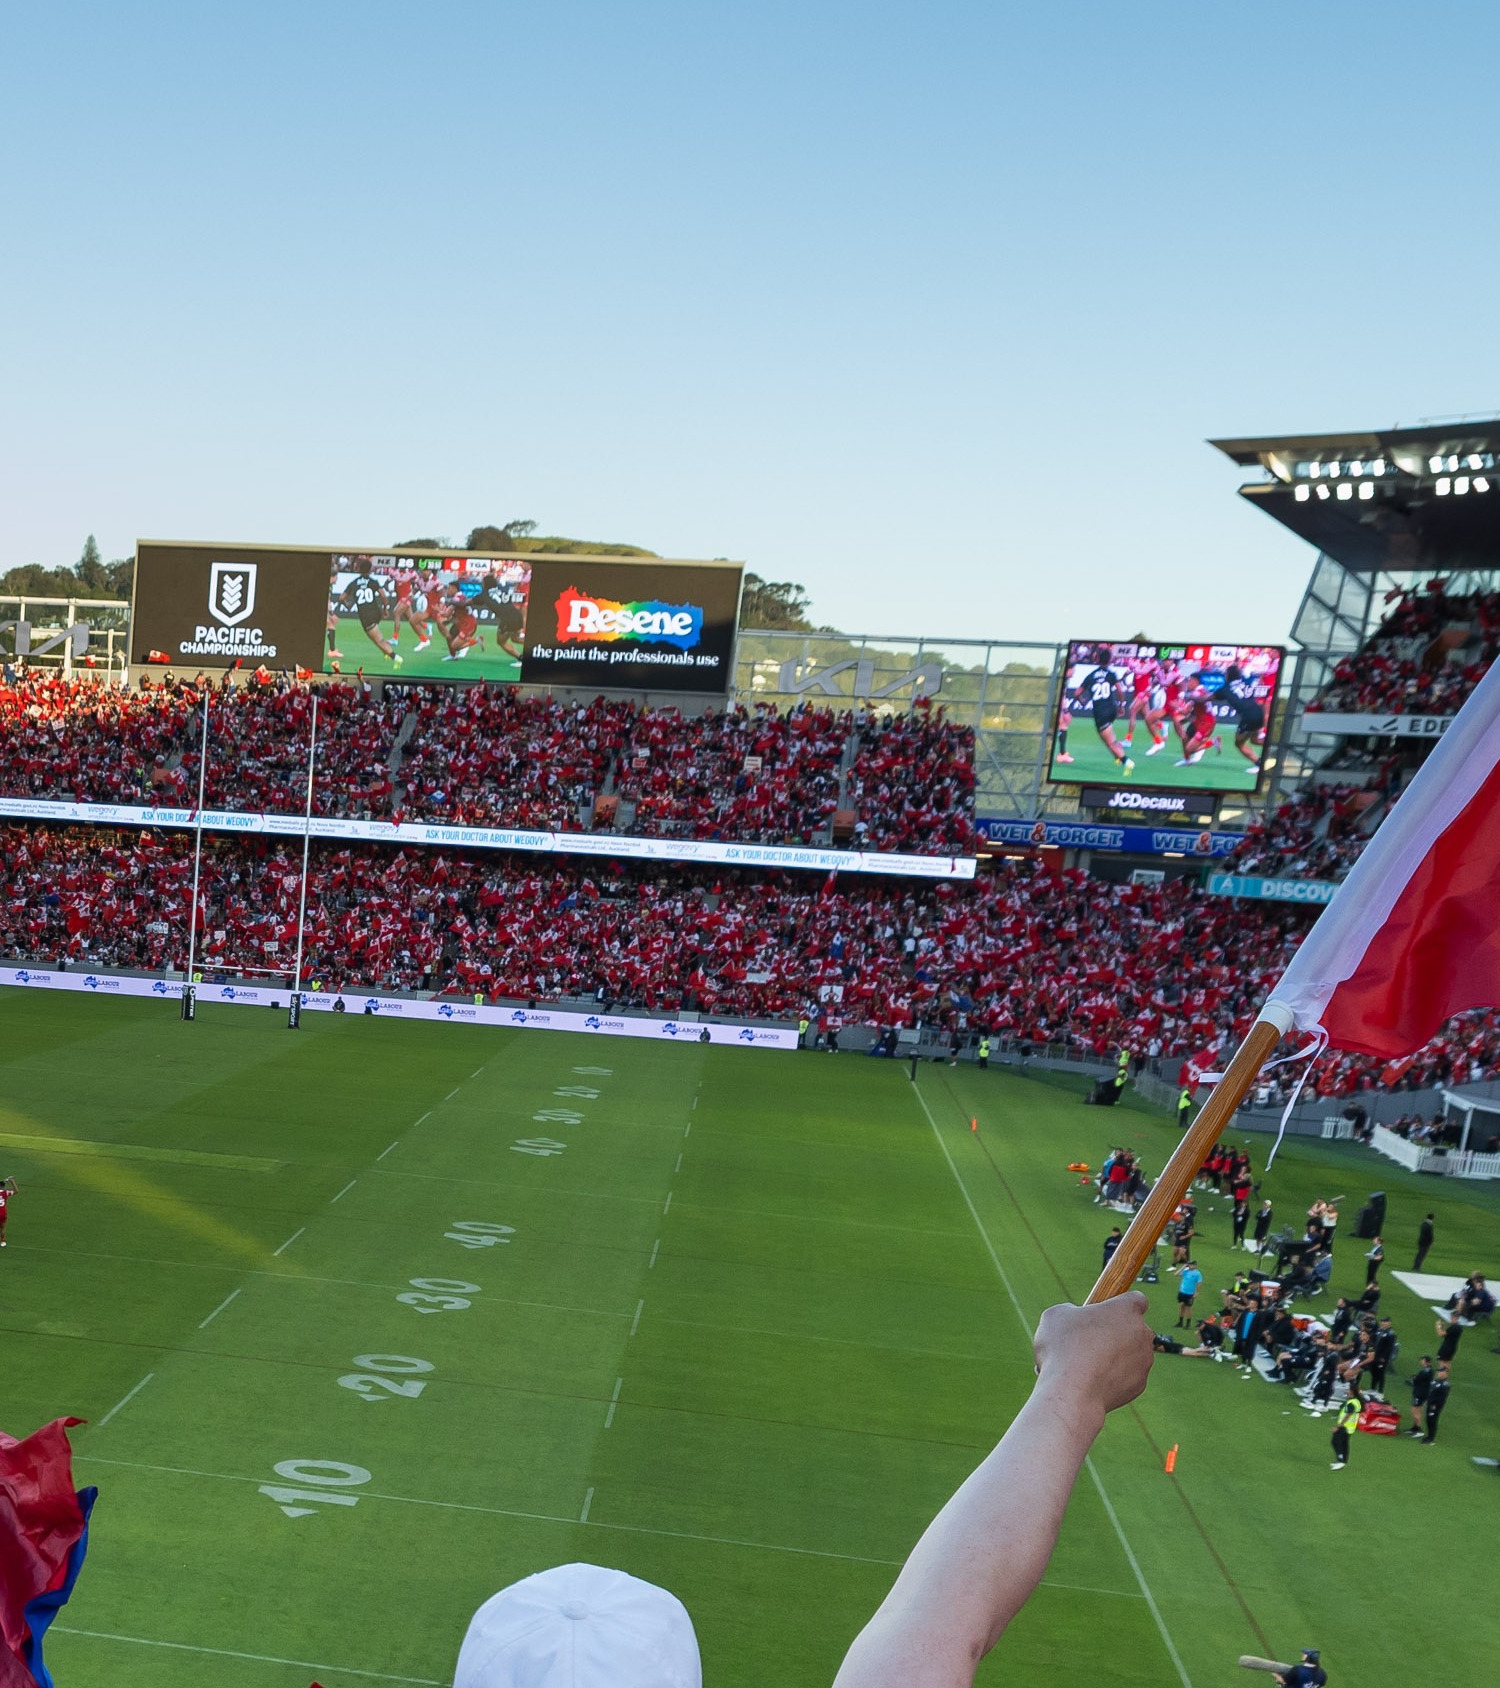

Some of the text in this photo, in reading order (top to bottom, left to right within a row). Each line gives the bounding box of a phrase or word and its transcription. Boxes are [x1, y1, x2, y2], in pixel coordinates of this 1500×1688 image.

[376, 558, 392, 567] NZ
[398, 558, 415, 569] 26
[451, 560, 460, 570] 6
[469, 561, 487, 570] TGA
[356, 588, 374, 604] 20
[567, 600, 693, 636] Resene
[195, 626, 263, 645] PACIFIC
[180, 641, 277, 658] CHAMPIONSHIPS
[533, 644, 719, 667] the paint the professionals use
[1138, 646, 1157, 658] 26
[1091, 682, 1111, 700] 20
[1408, 718, 1450, 734] EDE
[1109, 792, 1185, 811] JCDecaux
[88, 806, 120, 816] wegovy
[141, 811, 154, 821] ASK
[156, 812, 174, 822] YOUR
[203, 814, 224, 825] ABOUT
[425, 829, 439, 839] ASK
[441, 830, 459, 841] YOUR
[461, 831, 488, 842] DOCTOR
[490, 832, 512, 844] ABOUT
[990, 822, 1124, 848] WET&FORGET
[726, 848, 739, 859] ASK
[741, 849, 761, 860] YOUR
[763, 850, 791, 862] DOCTOR
[793, 852, 818, 864] ABOUT
[1260, 880, 1340, 900] DISCOV
[29, 974, 51, 983] LABOUR
[97, 979, 119, 988] LABOUR
[235, 990, 258, 998] LABOUR
[532, 1108, 585, 1124] 30
[510, 1137, 567, 1156] 40
[443, 1220, 516, 1247] 40
[395, 1277, 482, 1311] 30
[336, 1353, 436, 1399] 20
[258, 1459, 372, 1507] 10
